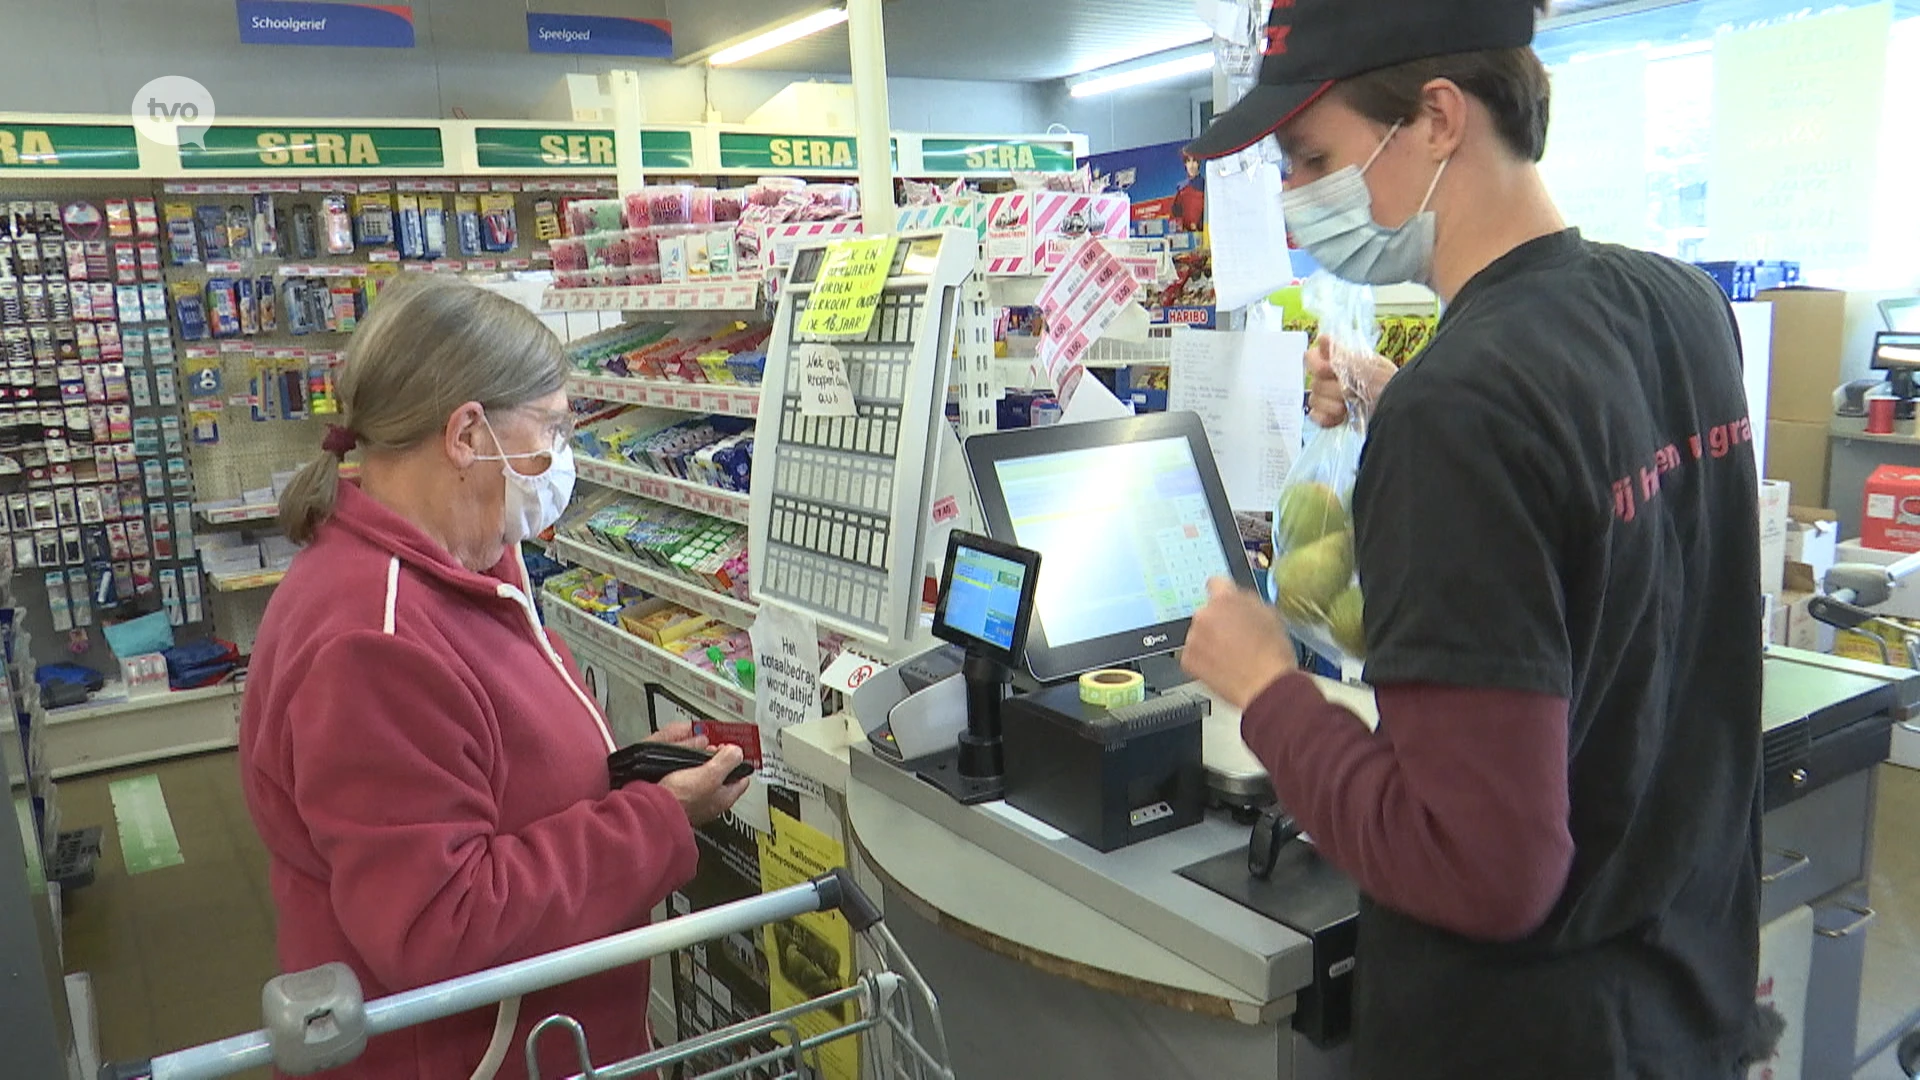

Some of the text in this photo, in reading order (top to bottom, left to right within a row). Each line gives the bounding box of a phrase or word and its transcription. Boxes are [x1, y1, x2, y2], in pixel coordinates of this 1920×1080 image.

[252, 16, 327, 32] Schoolgerief
[539, 27, 590, 42] Speelgoed
[256, 132, 380, 165] SERA
[541, 135, 615, 165] SER
[769, 138, 853, 167] SERA
[966, 143, 1036, 169] SERA
[1168, 308, 1208, 324] HARIBO
[782, 636, 798, 658] Het
[761, 653, 816, 691] totaalbedrag
[766, 676, 814, 709] wordt altijd
[768, 696, 806, 724] afgerond
